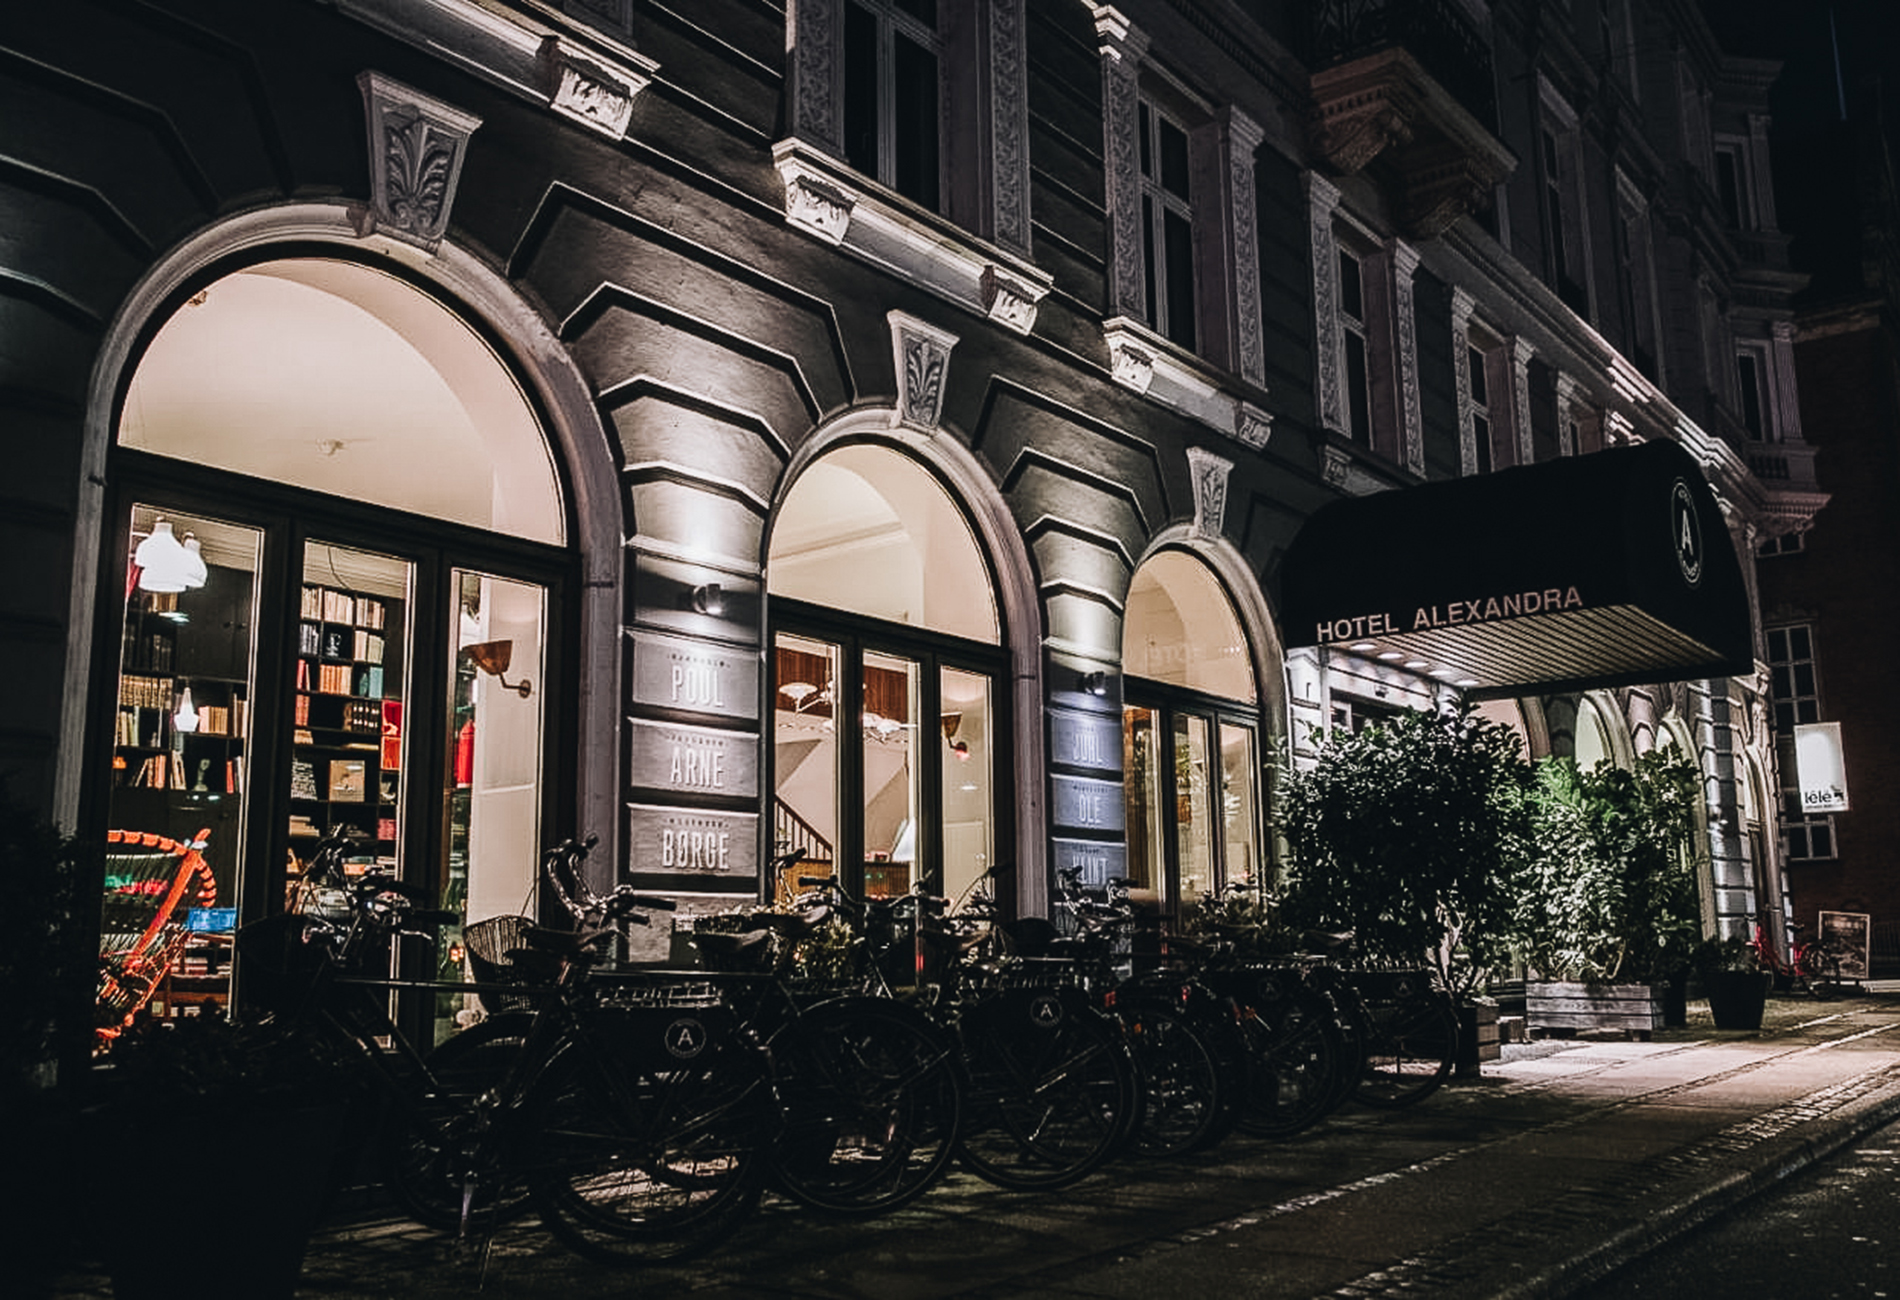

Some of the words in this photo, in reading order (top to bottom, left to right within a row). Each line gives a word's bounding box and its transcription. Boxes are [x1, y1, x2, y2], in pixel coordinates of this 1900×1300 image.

[1316, 613, 1400, 642] HOTEL
[1412, 586, 1583, 630] ALEXANDRA
[672, 665, 724, 706] POUL
[671, 747, 724, 788] ARNE
[1079, 794, 1102, 824] OLE
[662, 829, 730, 870] BØRGE
